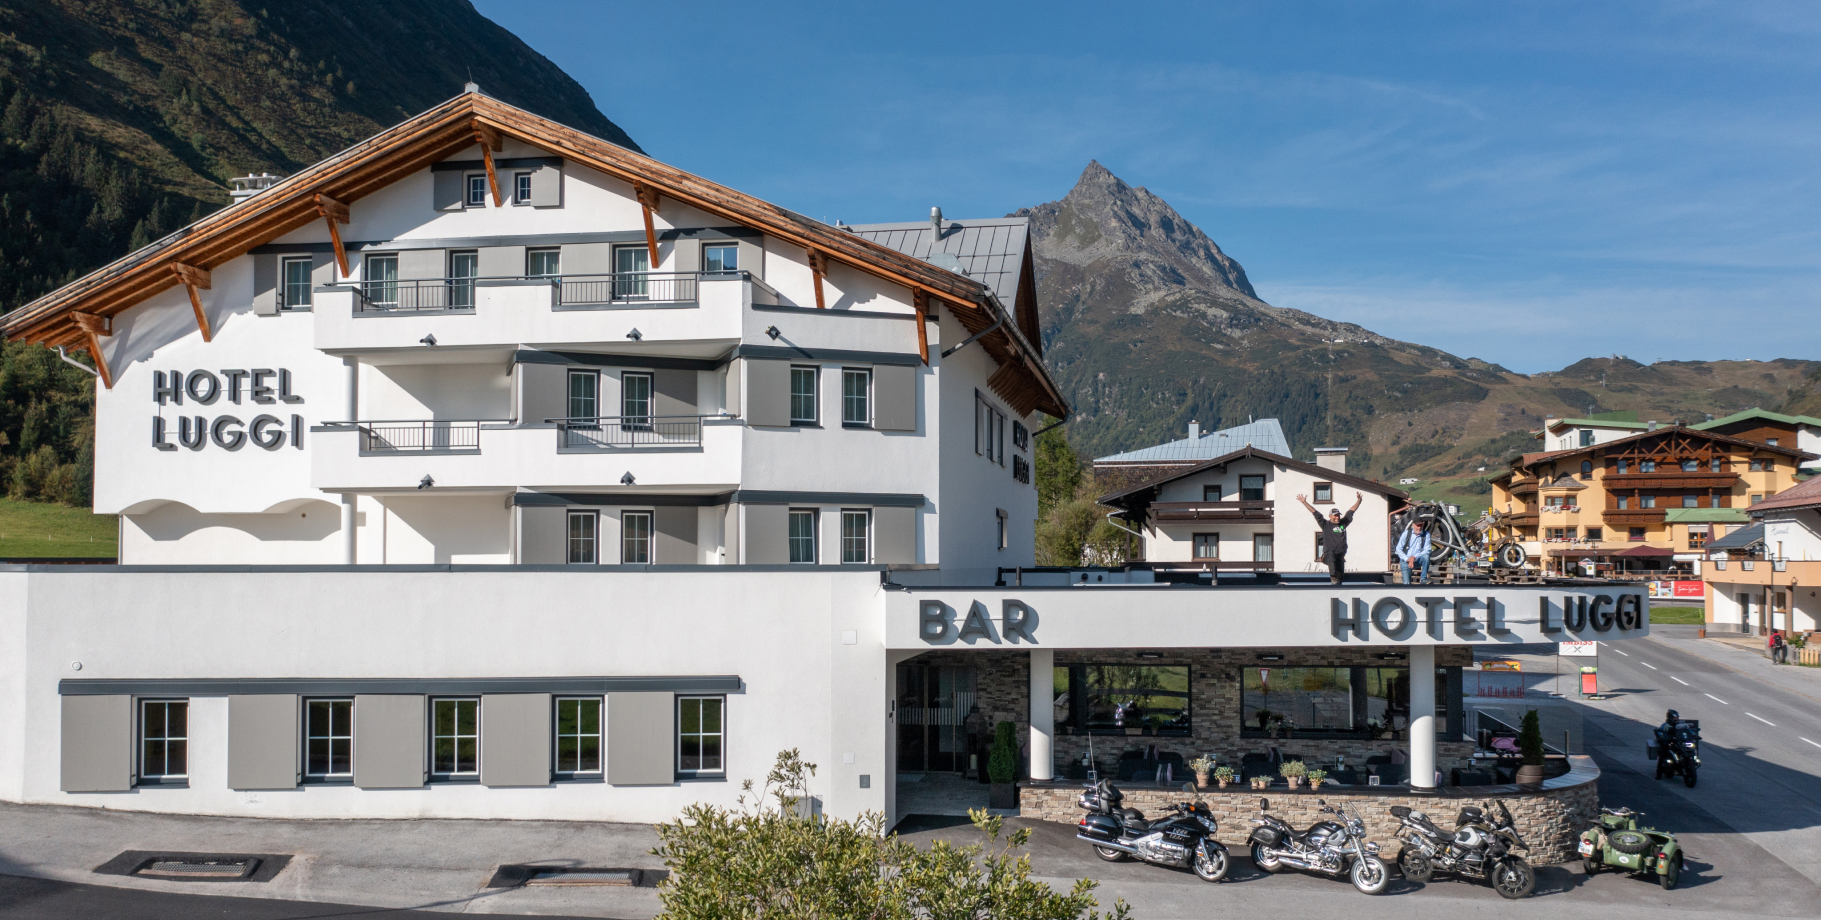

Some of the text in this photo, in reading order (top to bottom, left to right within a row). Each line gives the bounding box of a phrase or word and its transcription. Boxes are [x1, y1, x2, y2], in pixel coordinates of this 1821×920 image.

[153, 368, 301, 403] HOTEL
[152, 414, 302, 449] LUGGI
[919, 599, 1030, 640] BAR
[1331, 594, 1643, 636] HOTEL LUGGI
